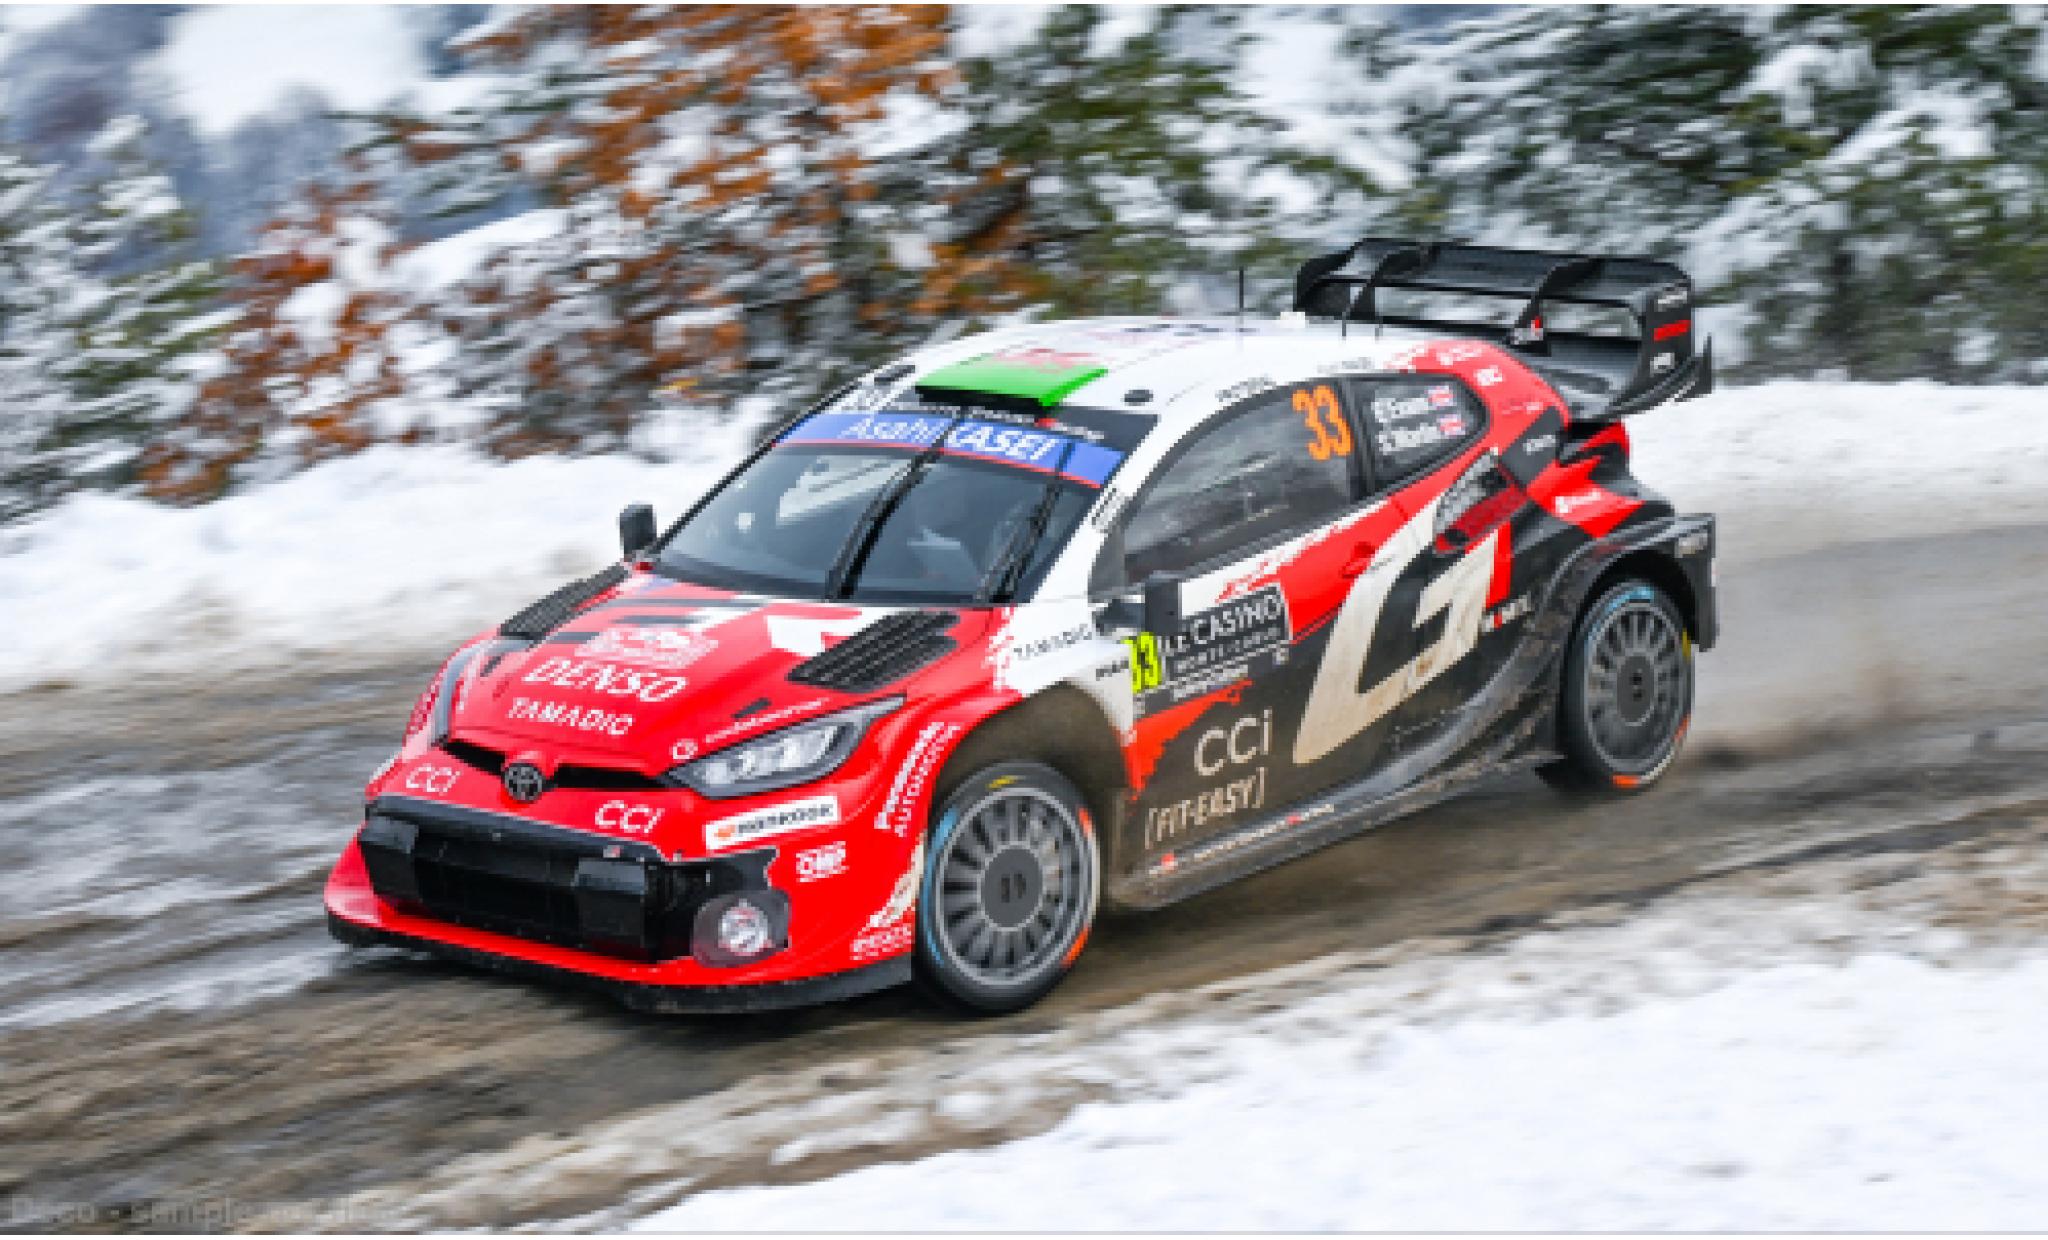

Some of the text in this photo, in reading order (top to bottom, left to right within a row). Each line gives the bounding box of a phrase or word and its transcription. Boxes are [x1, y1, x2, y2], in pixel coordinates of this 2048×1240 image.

[842, 417, 945, 444] Asahi
[1291, 384, 1354, 463] 33
[1190, 593, 1283, 647] CASINO
[522, 658, 688, 703] DENSO
[508, 697, 633, 736] TAMADIC
